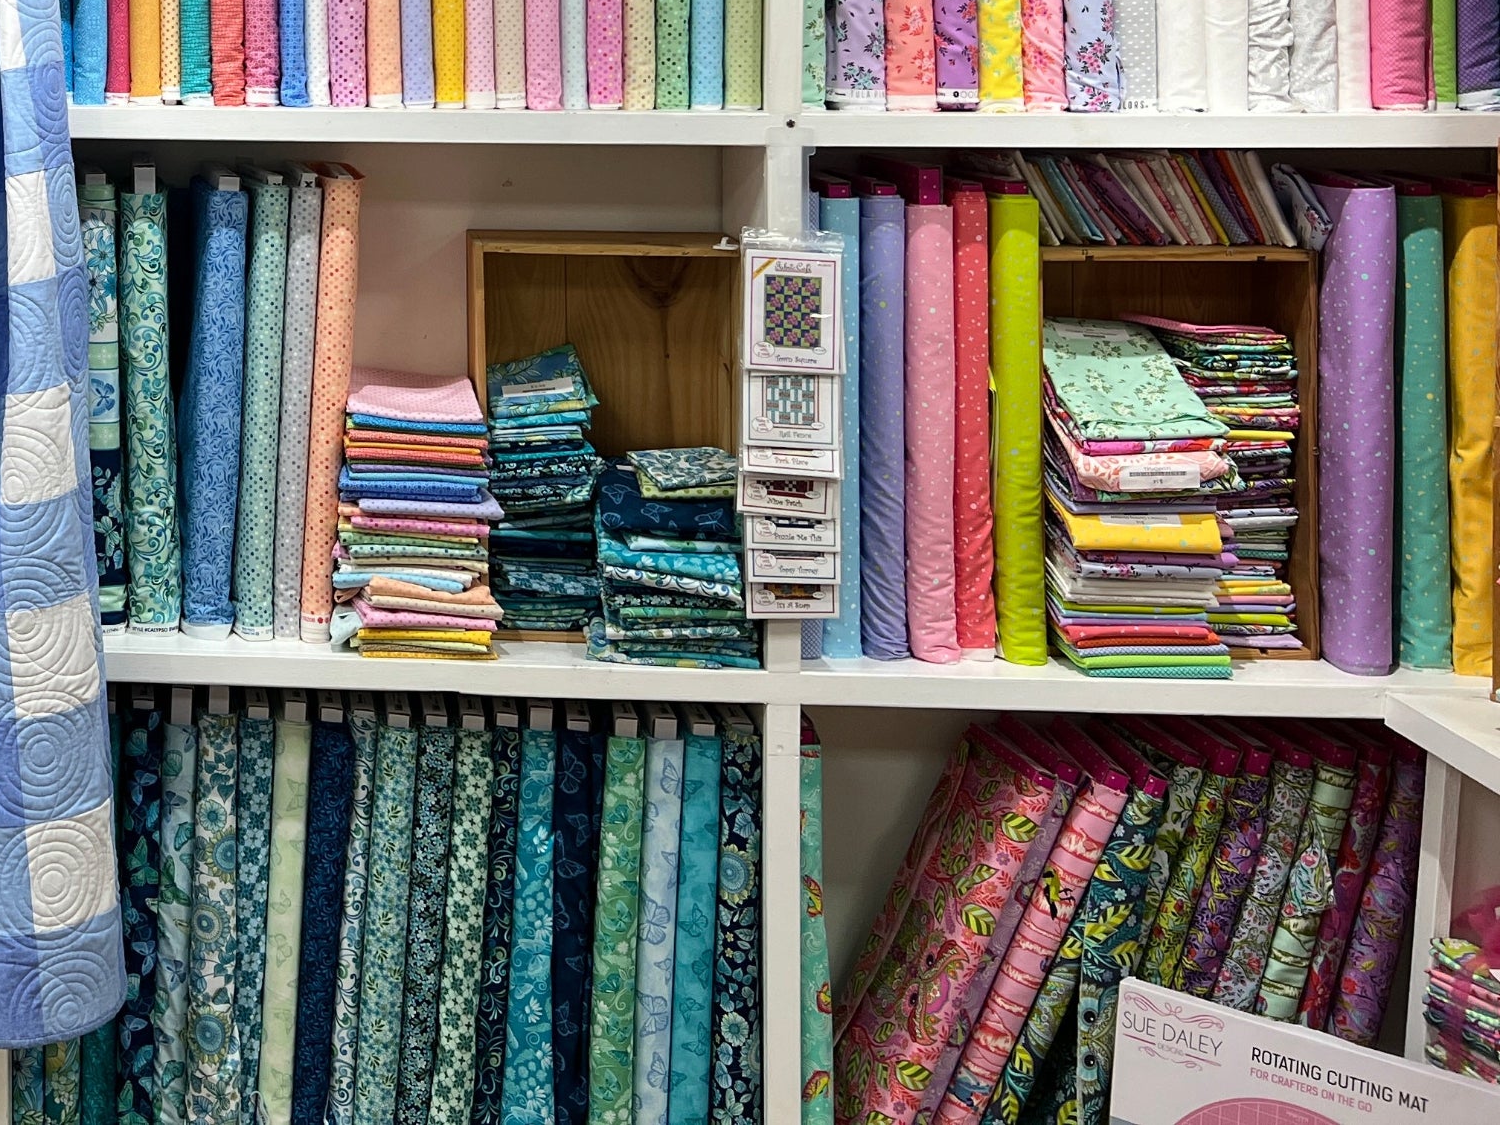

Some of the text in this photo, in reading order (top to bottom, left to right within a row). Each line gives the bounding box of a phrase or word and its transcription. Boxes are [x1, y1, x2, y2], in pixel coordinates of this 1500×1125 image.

[1121, 1010, 1223, 1057] SUE DALEY
[1250, 1067, 1373, 1113] FOR CRAFTERS ON THE GO
[1251, 1046, 1430, 1113] ROTATING CUTTING MAT
